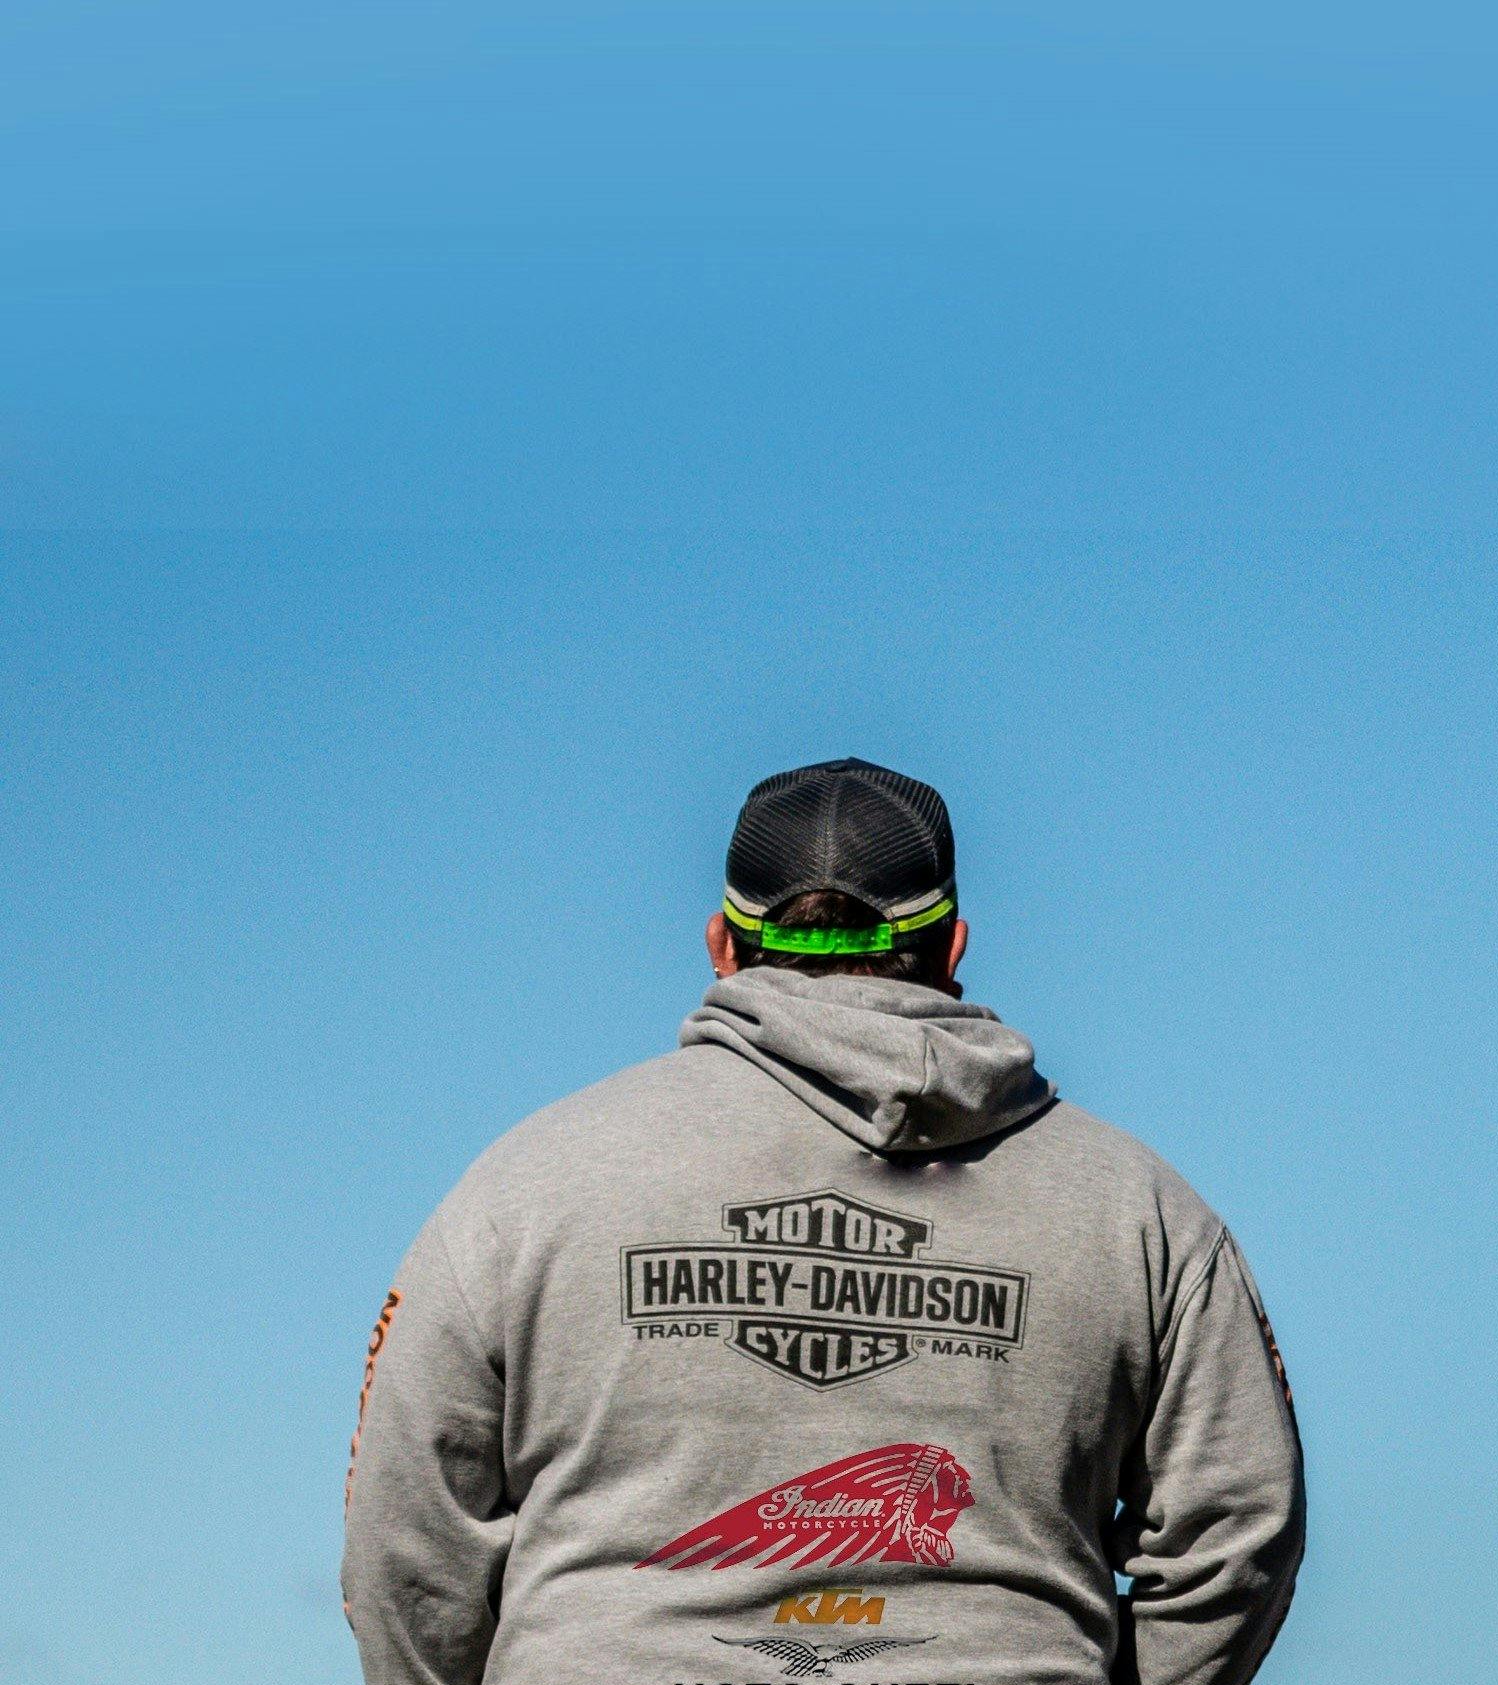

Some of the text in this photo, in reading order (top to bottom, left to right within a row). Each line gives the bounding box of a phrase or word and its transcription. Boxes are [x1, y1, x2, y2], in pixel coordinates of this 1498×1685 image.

[744, 1199, 906, 1255] MOTOR
[642, 1258, 1009, 1331] HARLEY-DAVIDSON
[633, 1321, 1011, 1365] TRADE MARK
[744, 1325, 899, 1381] CYCLES
[757, 1485, 883, 1521] Indian
[762, 1518, 882, 1531] MOTORCYCLE
[772, 1588, 887, 1625] KTM
